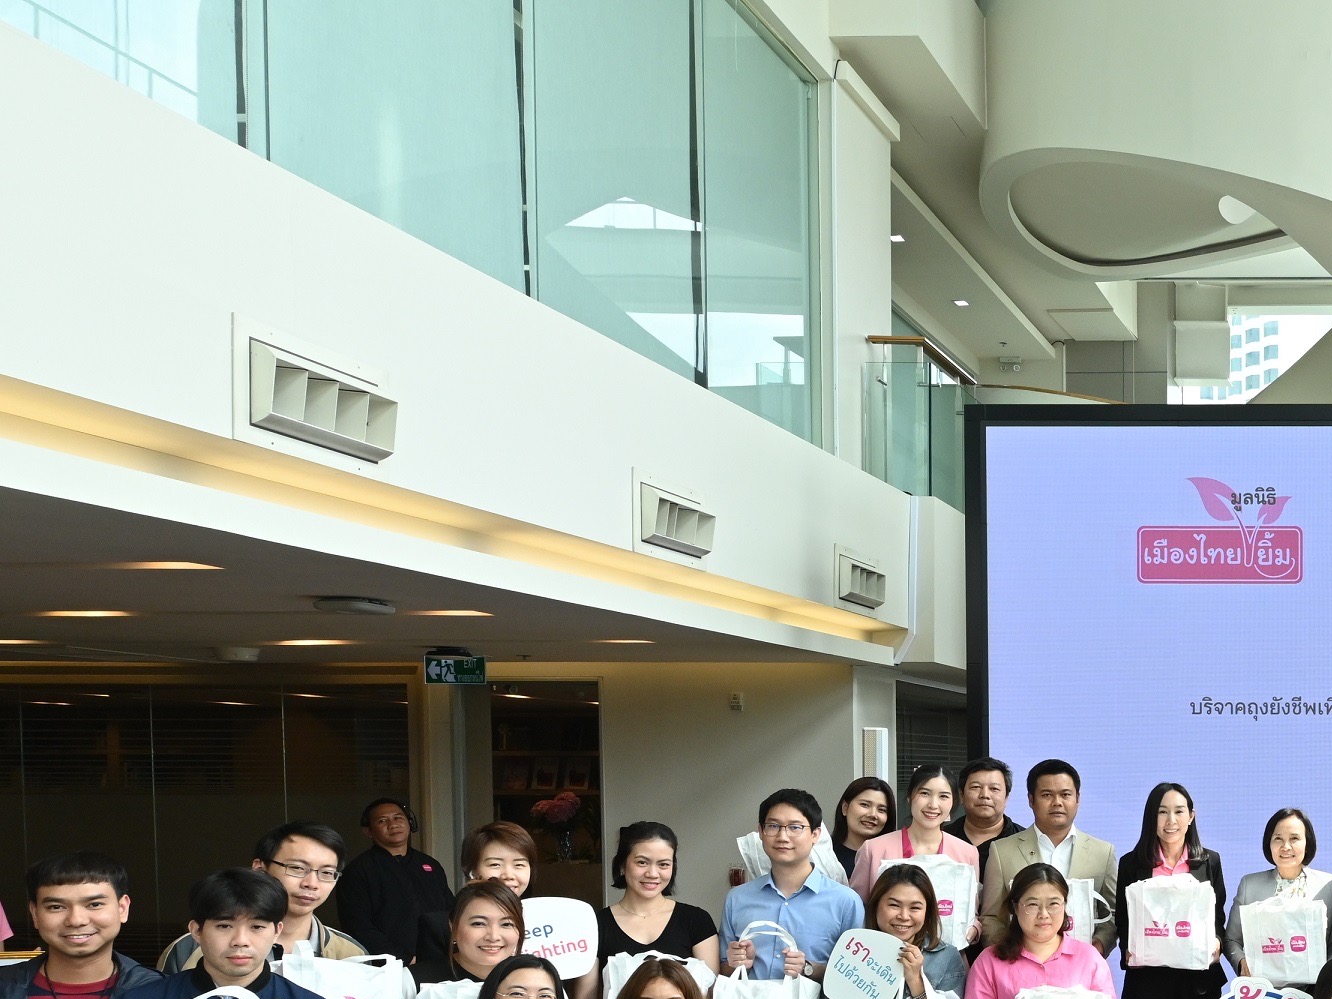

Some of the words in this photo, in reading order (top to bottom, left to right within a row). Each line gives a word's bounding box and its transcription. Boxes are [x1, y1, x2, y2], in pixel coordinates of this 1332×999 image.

[1230, 486, 1277, 512] มูลนิธิ
[463, 658, 477, 669] EXIT
[524, 924, 553, 940] eep
[521, 939, 589, 958] hting
